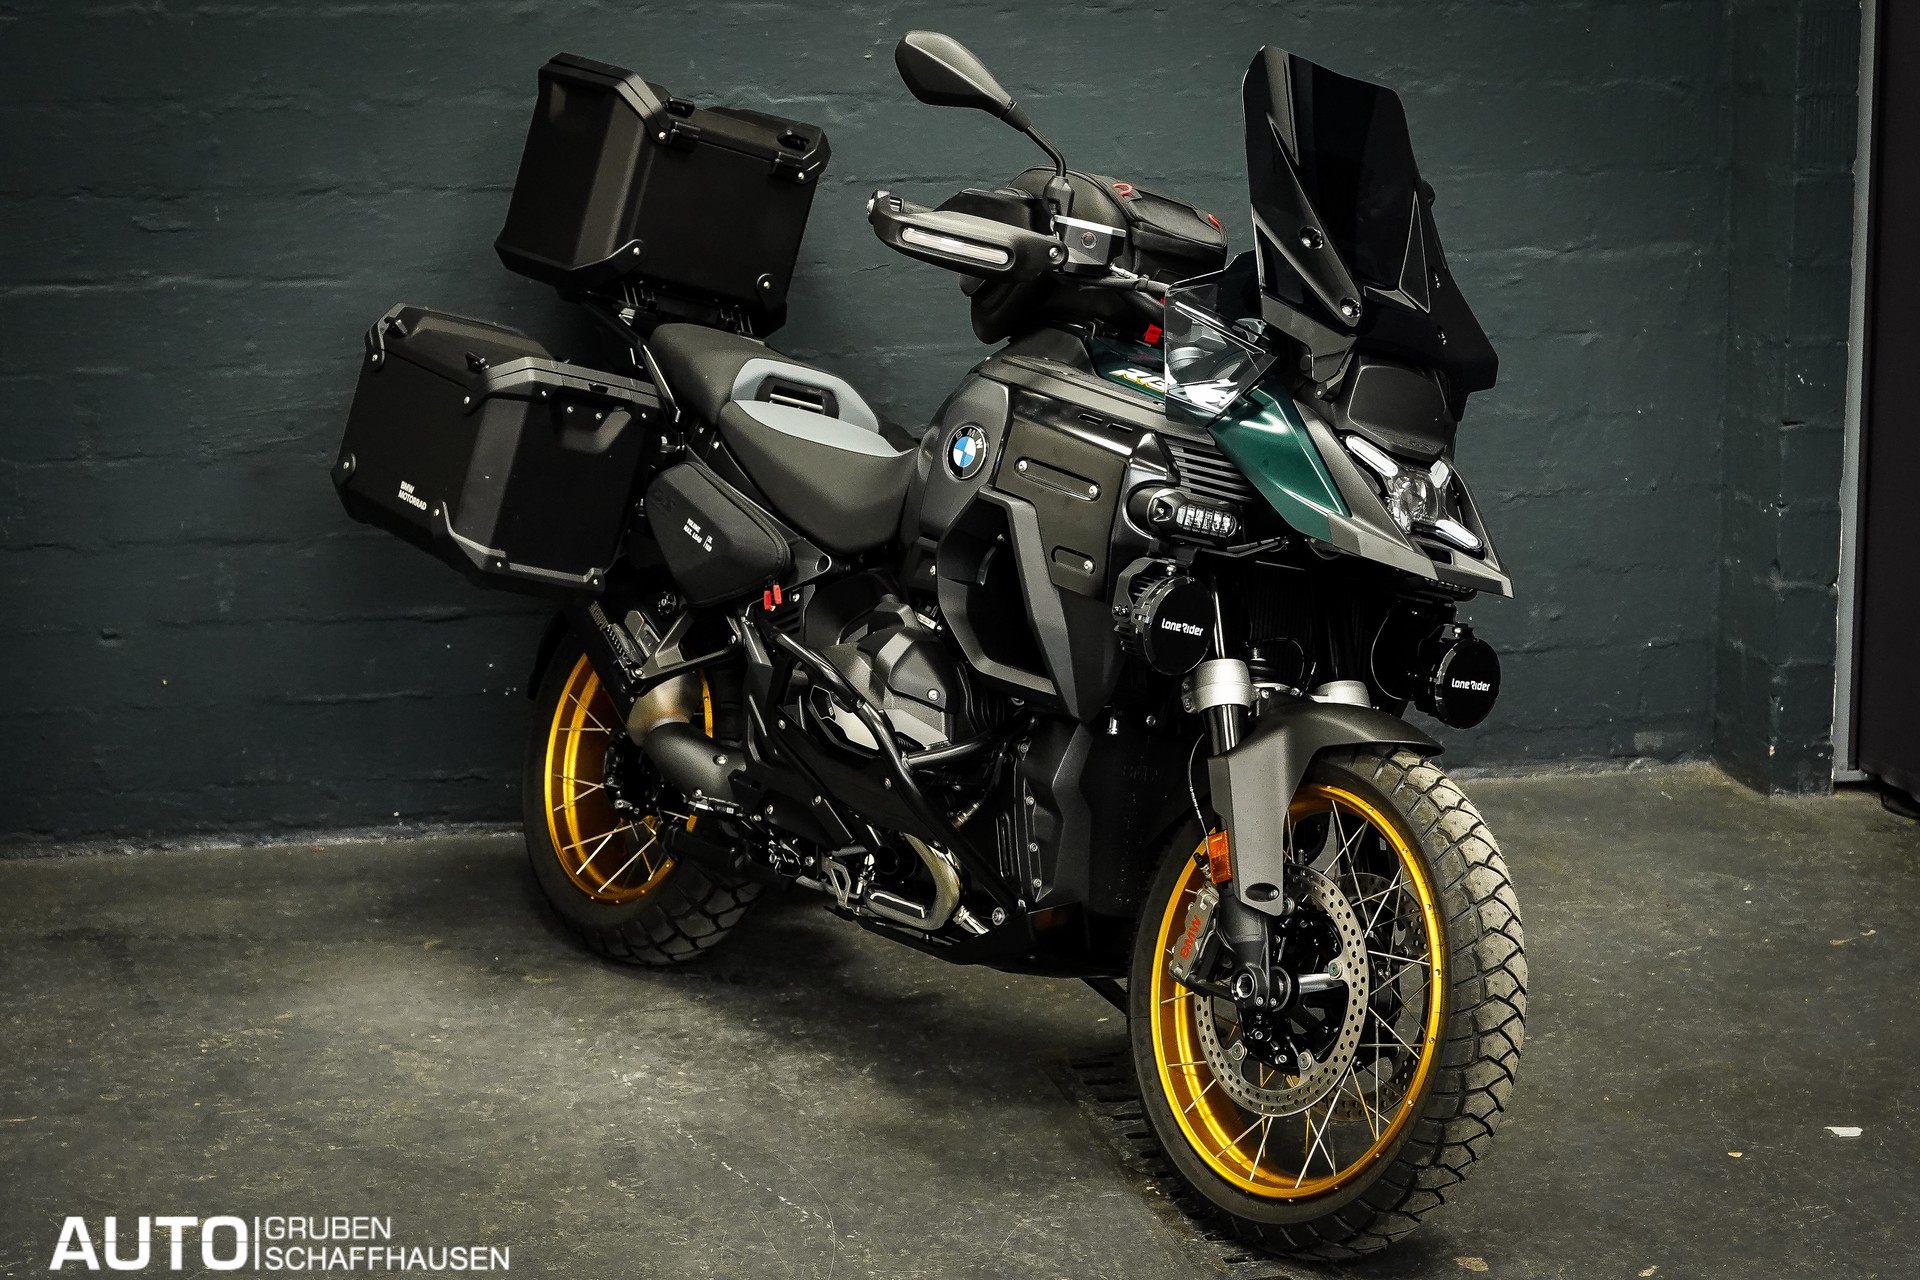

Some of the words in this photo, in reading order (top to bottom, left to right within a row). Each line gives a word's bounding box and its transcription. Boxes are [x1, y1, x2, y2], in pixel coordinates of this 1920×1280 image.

[955, 427, 984, 449] BMW
[400, 480, 415, 494] BMW
[397, 489, 428, 511] MOTORRAD
[1161, 617, 1182, 633] Lone
[1182, 622, 1204, 637] Rider
[1451, 677, 1470, 690] Lone
[1470, 680, 1491, 692] Rider
[1179, 914, 1202, 960] BMW
